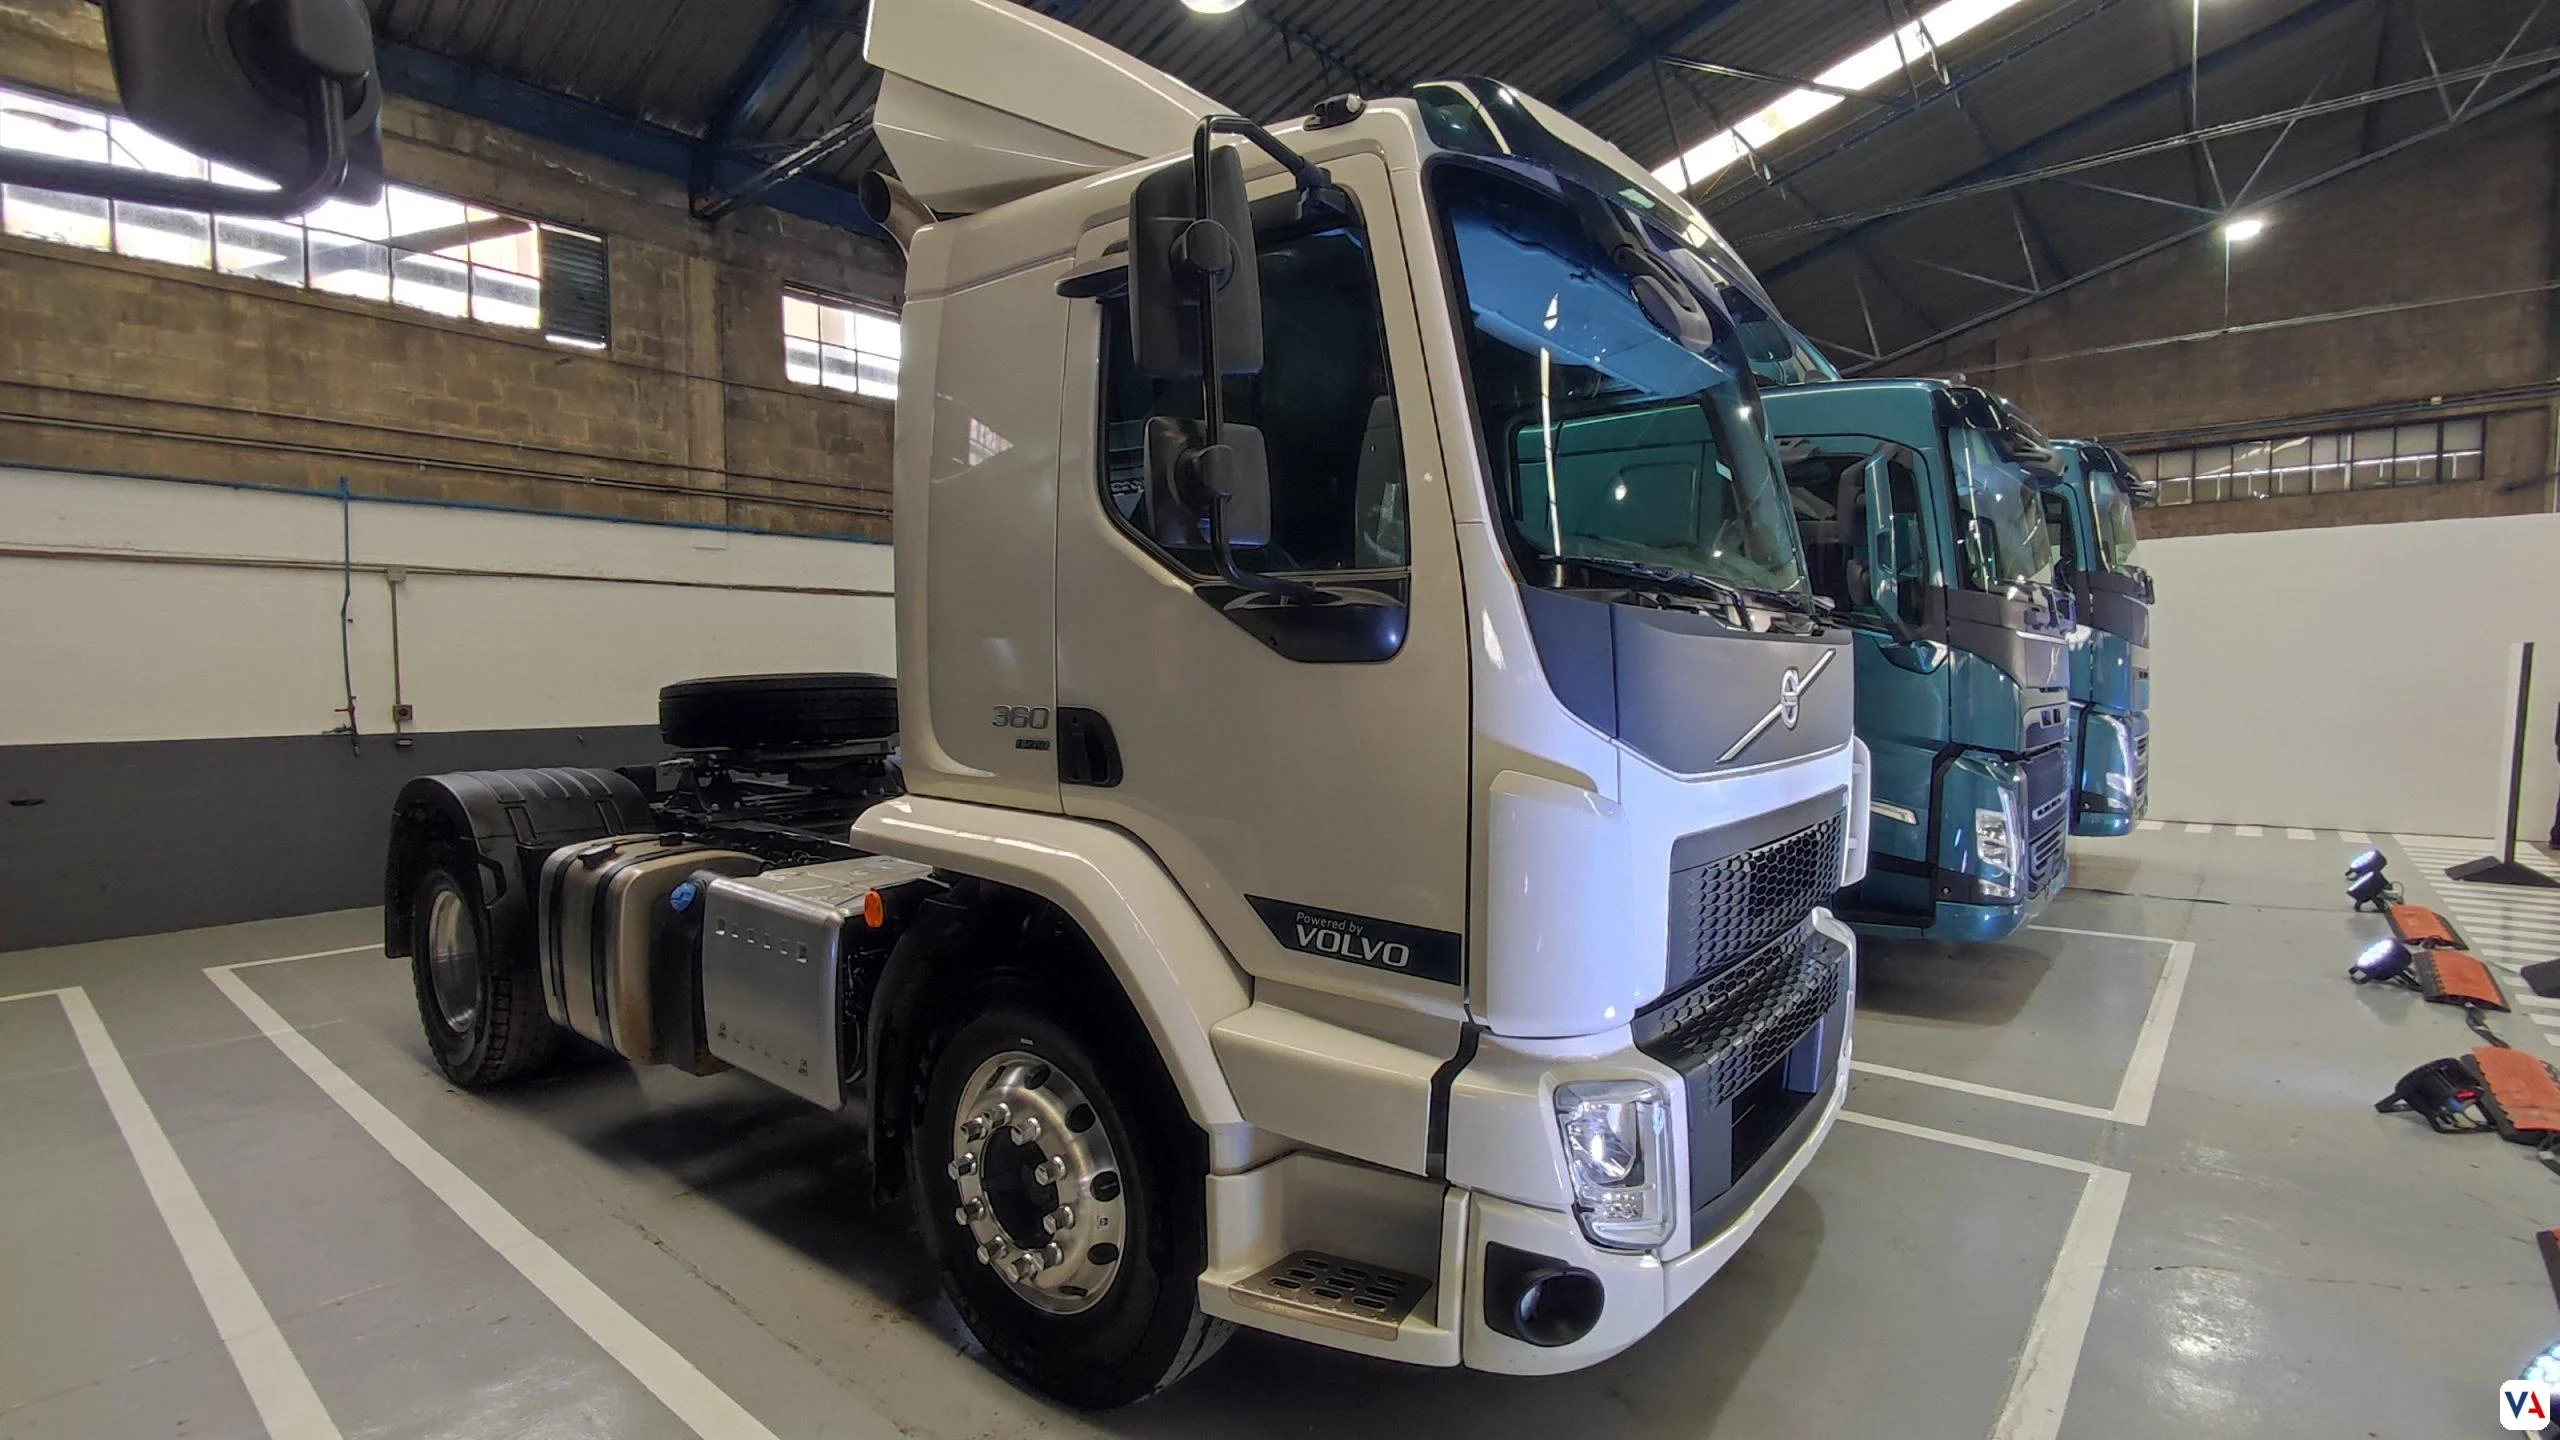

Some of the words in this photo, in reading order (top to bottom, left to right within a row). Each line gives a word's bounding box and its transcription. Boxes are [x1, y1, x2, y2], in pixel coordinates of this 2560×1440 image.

[992, 704, 1050, 730] 360
[1296, 912, 1346, 930] Powered
[1348, 921, 1364, 935] by
[1296, 924, 1410, 967] VOLVO
